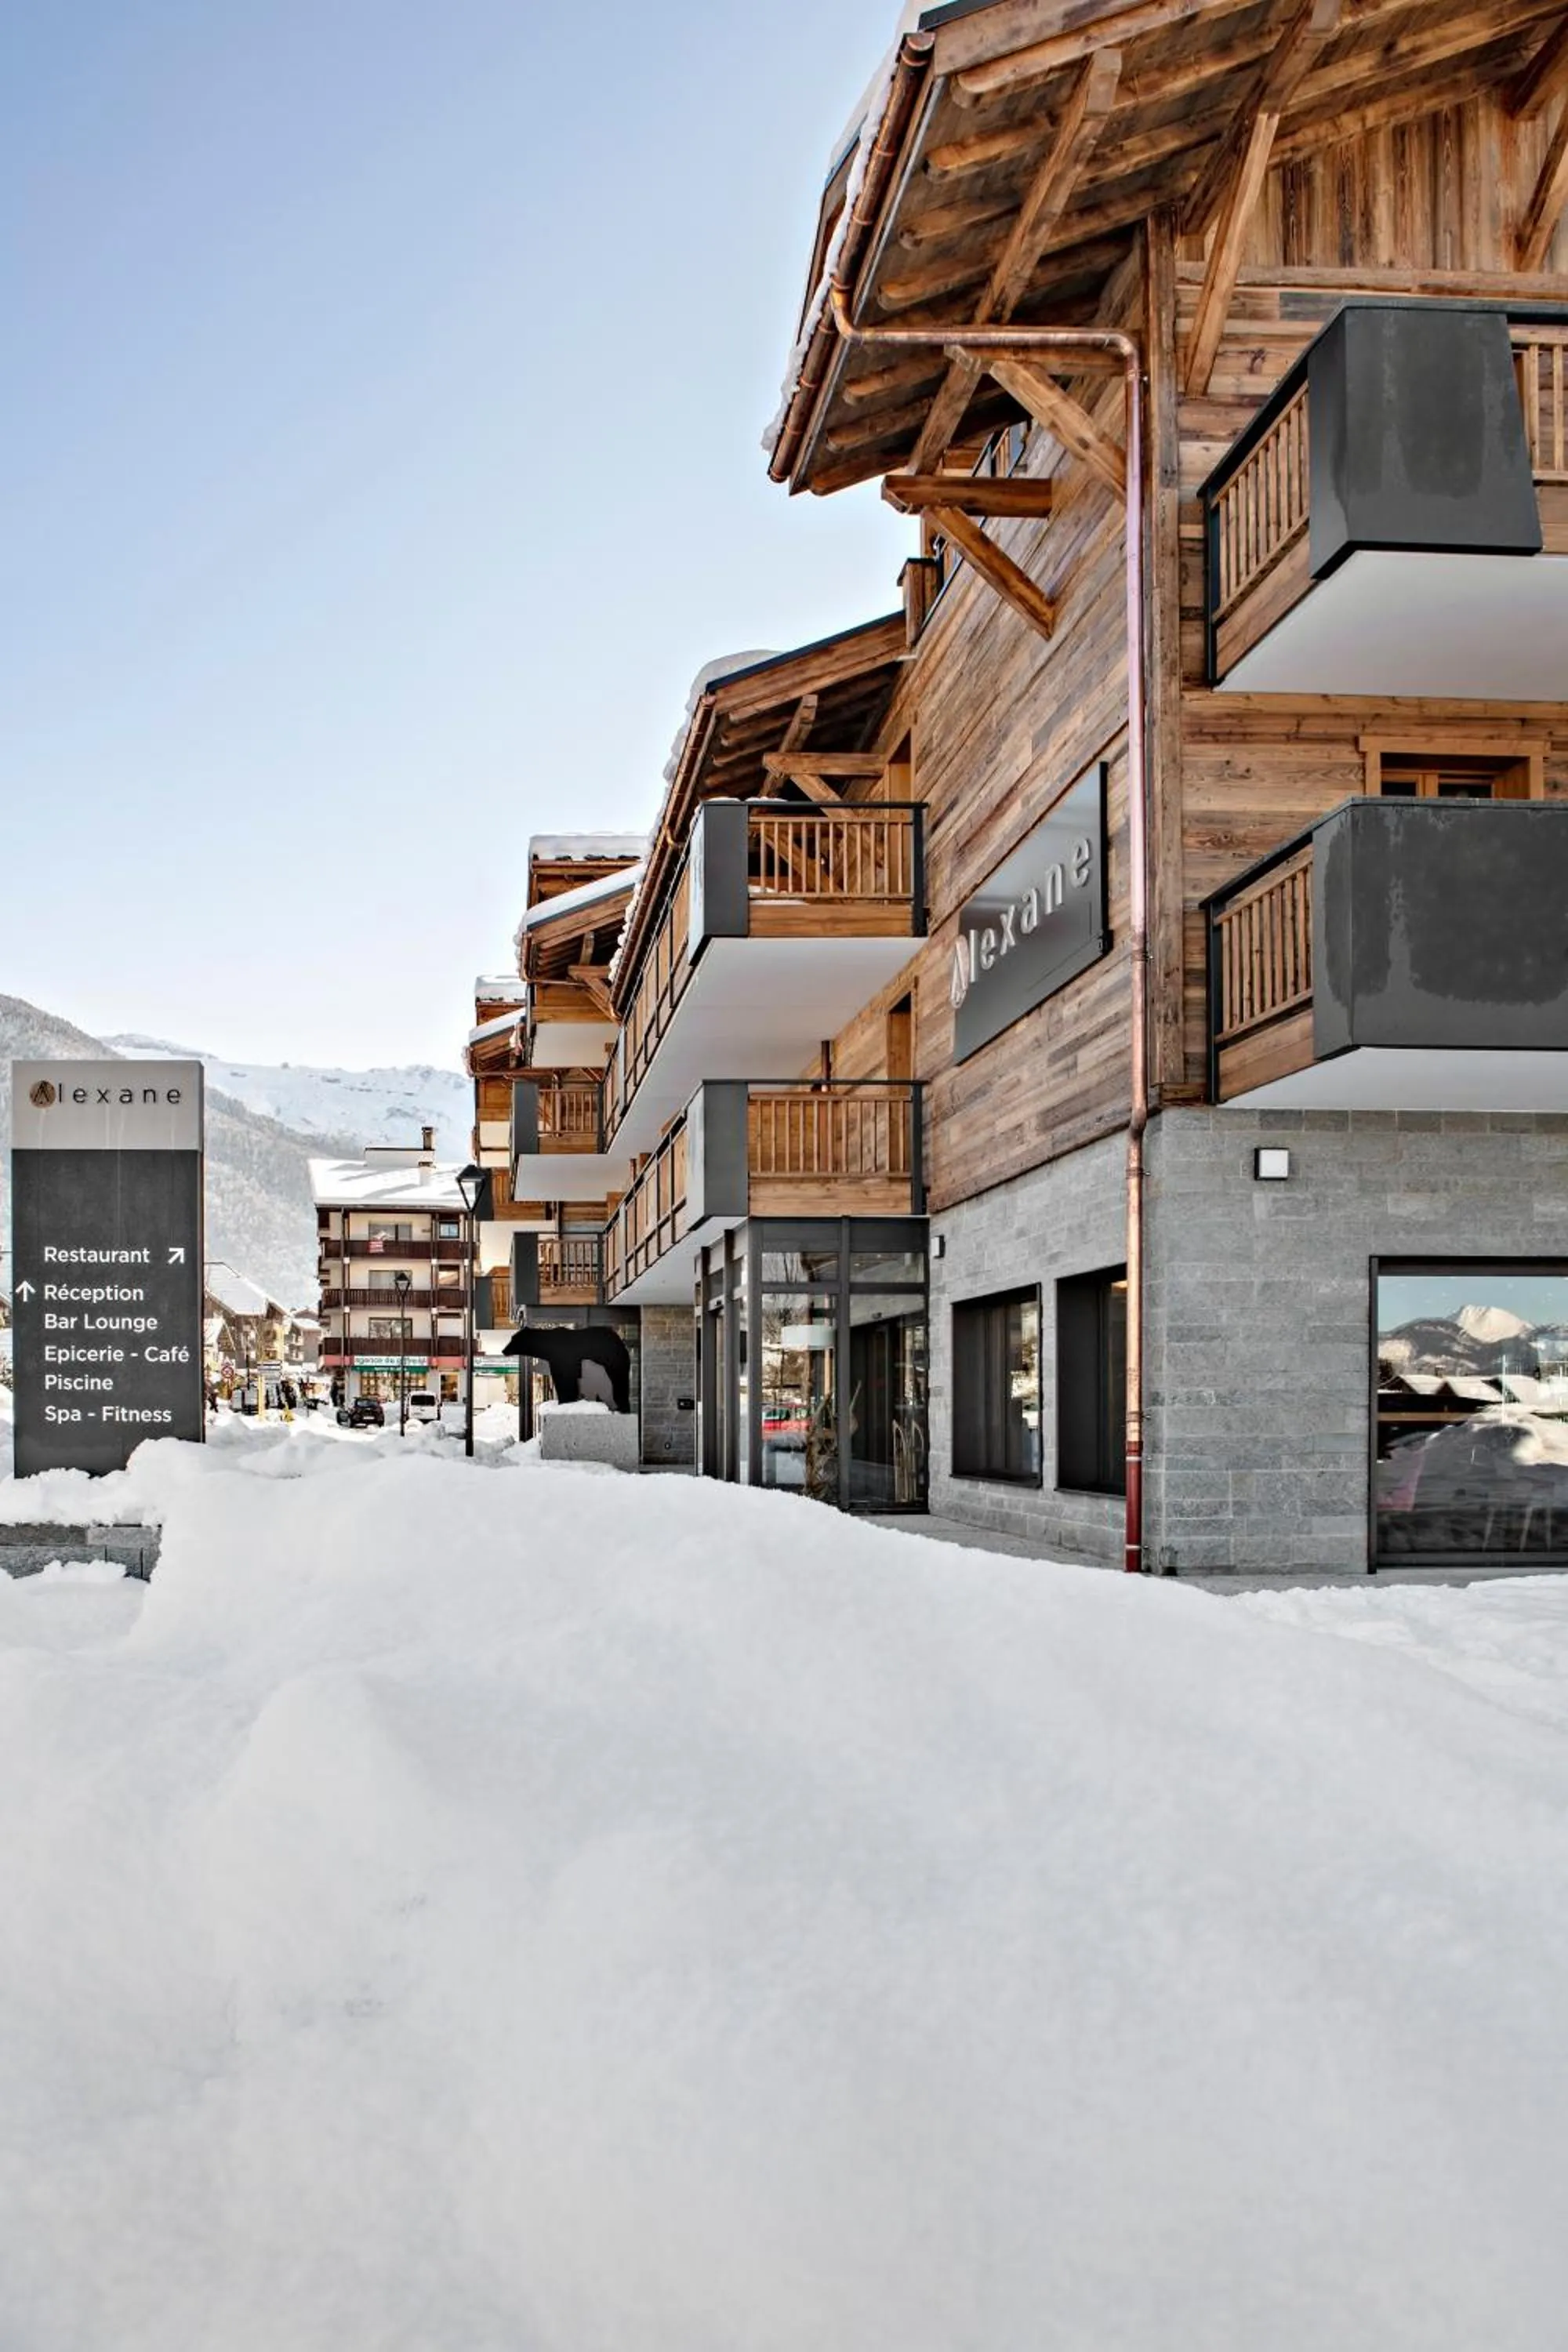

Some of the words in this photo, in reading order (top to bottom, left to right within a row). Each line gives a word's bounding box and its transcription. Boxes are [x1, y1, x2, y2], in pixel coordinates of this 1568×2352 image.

[949, 837, 1091, 1009] Alexane
[30, 1080, 182, 1107] Alexane
[44, 1246, 151, 1264] Restaurant
[44, 1283, 144, 1304] Réception
[44, 1314, 78, 1330] Bar
[84, 1314, 158, 1334] Lounge
[44, 1345, 125, 1365] Epicerie
[143, 1345, 191, 1363] Café
[45, 1374, 114, 1391] Piscine
[45, 1406, 82, 1425] Spa
[102, 1405, 172, 1422] Fitness
